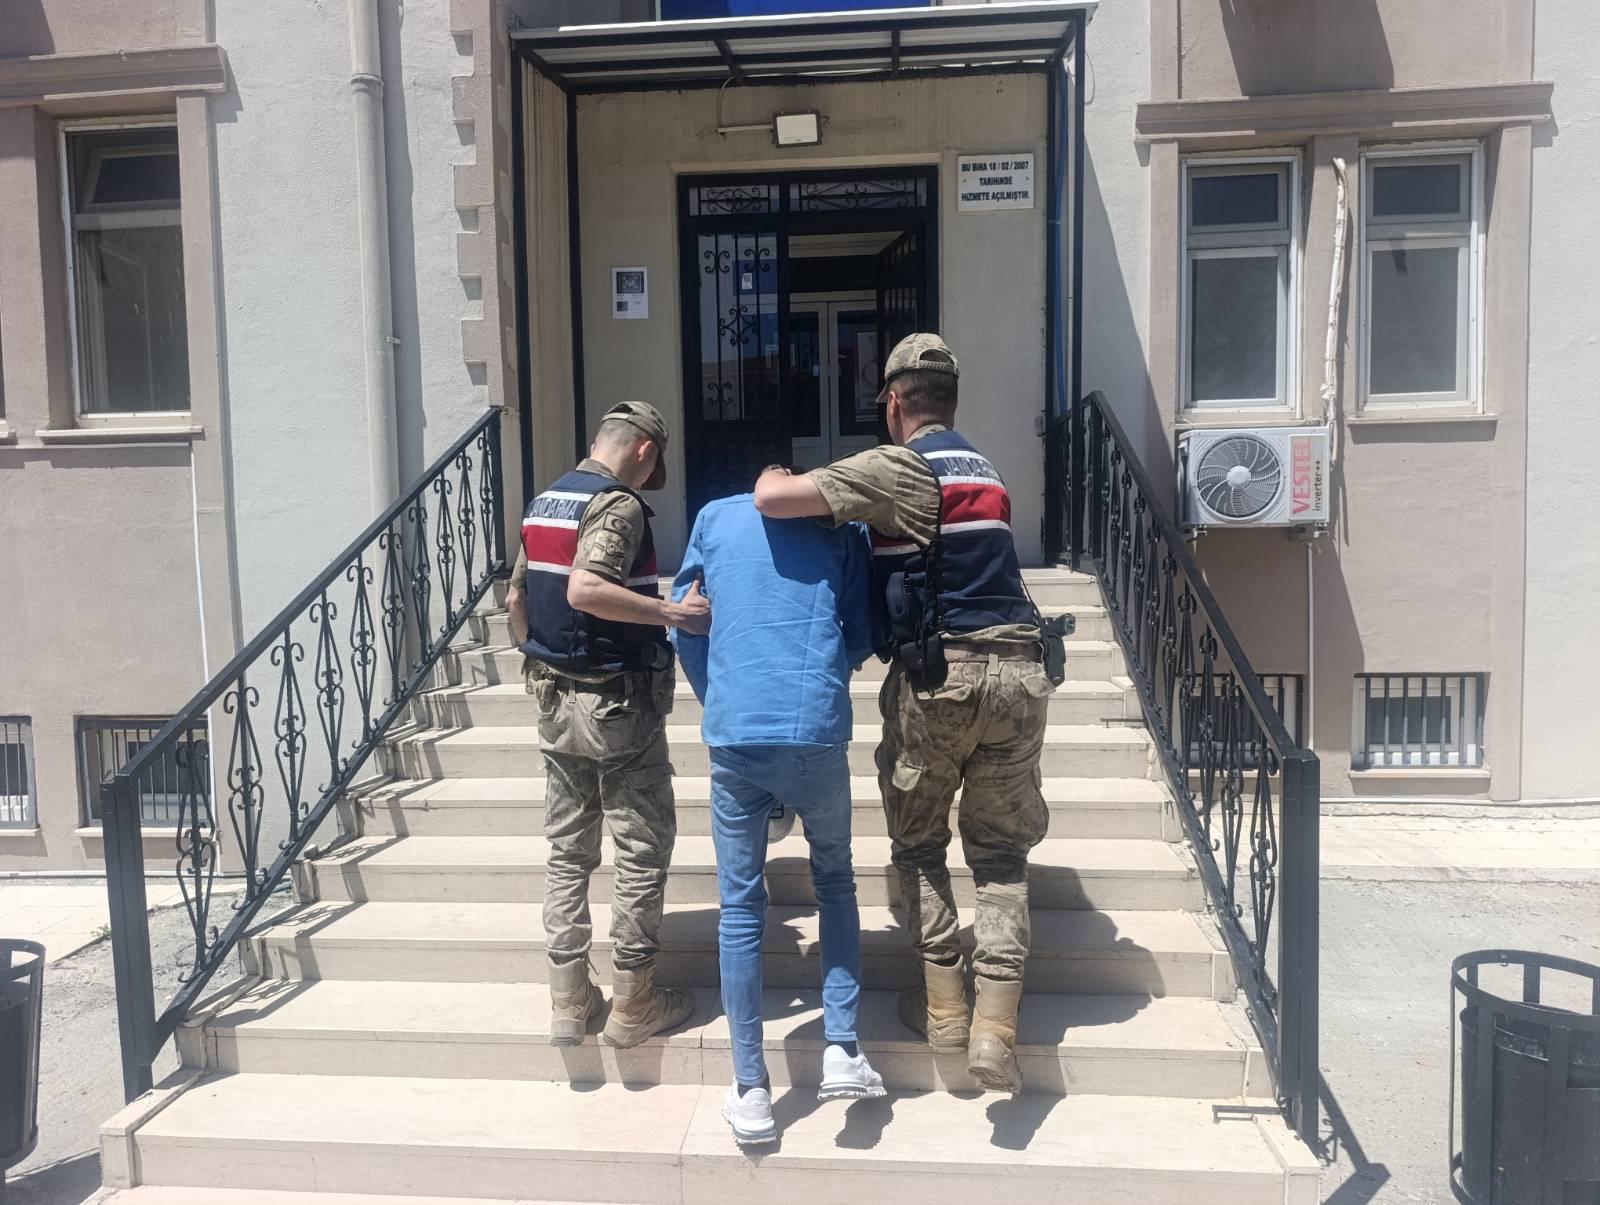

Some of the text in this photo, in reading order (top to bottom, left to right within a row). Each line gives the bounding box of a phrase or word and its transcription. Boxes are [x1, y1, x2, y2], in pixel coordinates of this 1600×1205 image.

[962, 163, 970, 172] BU
[989, 162, 996, 170] 18
[1001, 162, 1009, 170] 02
[1014, 161, 1029, 170] 2007
[1293, 438, 1312, 514] VESTEL
